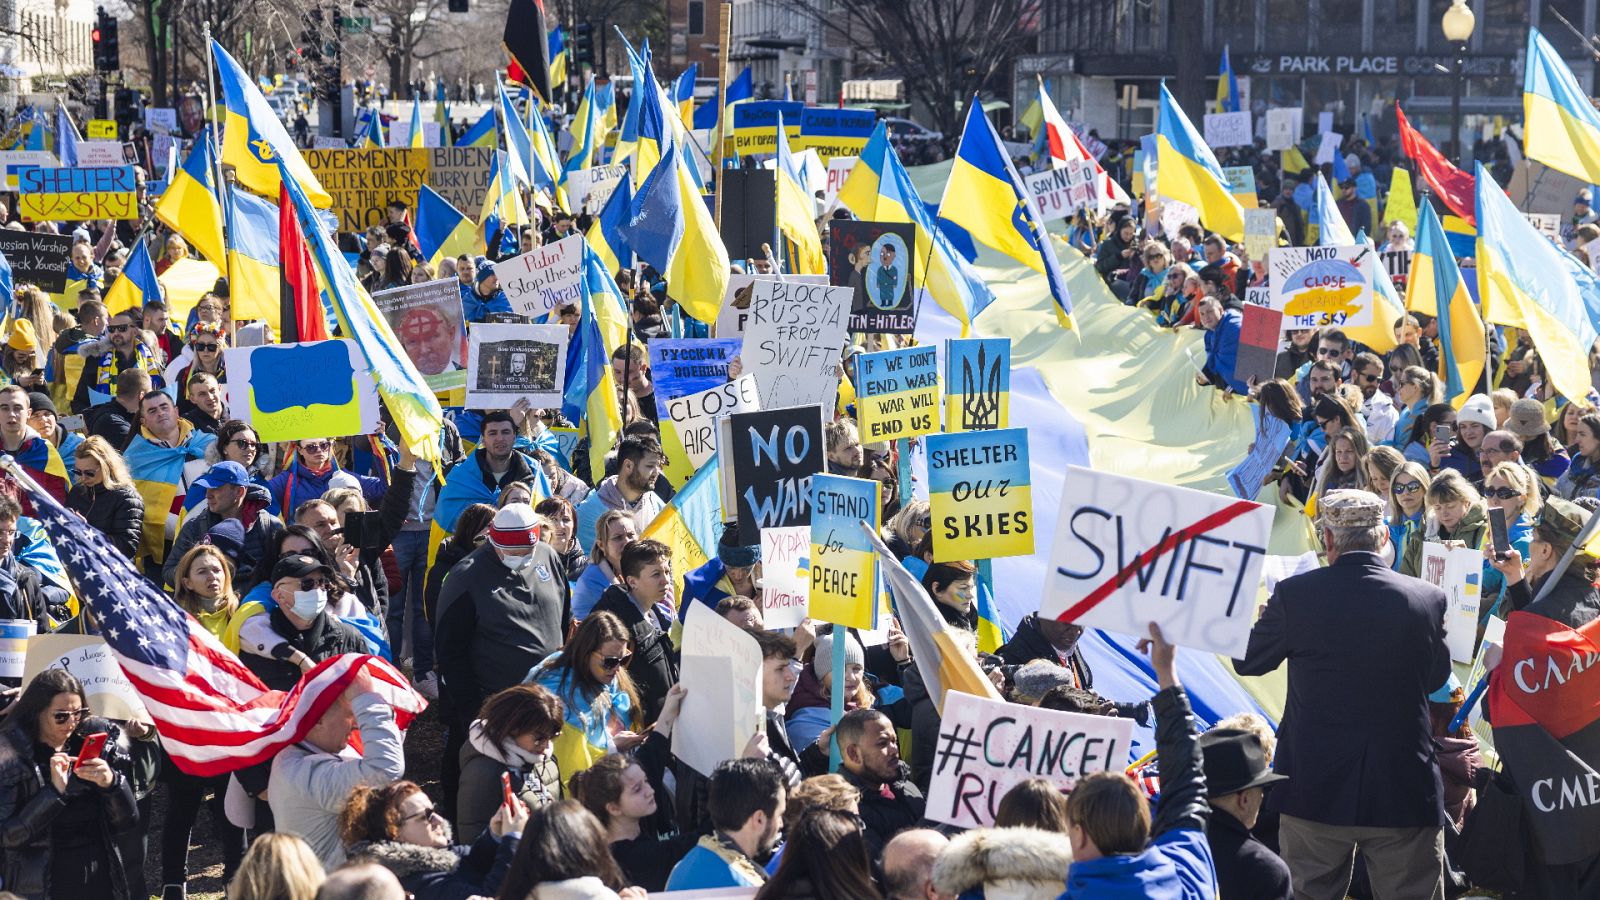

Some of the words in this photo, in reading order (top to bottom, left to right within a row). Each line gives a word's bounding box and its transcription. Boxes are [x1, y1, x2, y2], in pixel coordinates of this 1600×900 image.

[1279, 57, 1330, 72] PARK
[1336, 57, 1397, 72] PLACE
[1404, 56, 1506, 73] GOUMET
[737, 135, 751, 147] ВИ
[301, 149, 412, 169] OVERMENT
[435, 150, 491, 167] BIDEN
[24, 168, 134, 193] SHELTER
[317, 172, 369, 190] HELTER
[372, 170, 400, 188] OUR
[401, 168, 426, 188] SKY
[428, 171, 469, 187] HURRY
[1033, 179, 1054, 195] SAY
[73, 192, 131, 218] SKY
[356, 190, 380, 208] THE
[1037, 183, 1098, 215] PUTN
[0, 240, 29, 251] ussian
[31, 238, 68, 255] Warship
[1305, 247, 1337, 263] NATO
[508, 277, 544, 298] Stop
[545, 268, 566, 284] the
[771, 282, 836, 305] BLOCK
[1304, 276, 1346, 288] CLOSE
[524, 301, 536, 312] in
[753, 296, 841, 326] RUSSIA
[1293, 314, 1315, 326] THE
[1319, 312, 1348, 326] SKY
[777, 326, 820, 341] FROM
[759, 341, 840, 368] SWIFT
[865, 359, 875, 374] IF
[885, 356, 904, 372] WE
[909, 351, 938, 370] DON'T
[866, 378, 900, 395] END
[905, 370, 938, 390] WAR
[670, 378, 752, 422] CLOSE
[879, 398, 905, 414] WAR
[911, 392, 934, 408] WILL
[871, 419, 902, 438] END
[911, 414, 932, 431] US
[748, 424, 811, 471] NO
[932, 444, 1017, 469] SHELTER
[744, 474, 813, 528] WAR
[817, 490, 870, 520] STAND
[944, 511, 1029, 540] SKIES
[818, 528, 844, 555] for
[1057, 505, 1266, 617] SWIFT
[812, 564, 858, 598] PEACE
[764, 588, 806, 610] Ukraine
